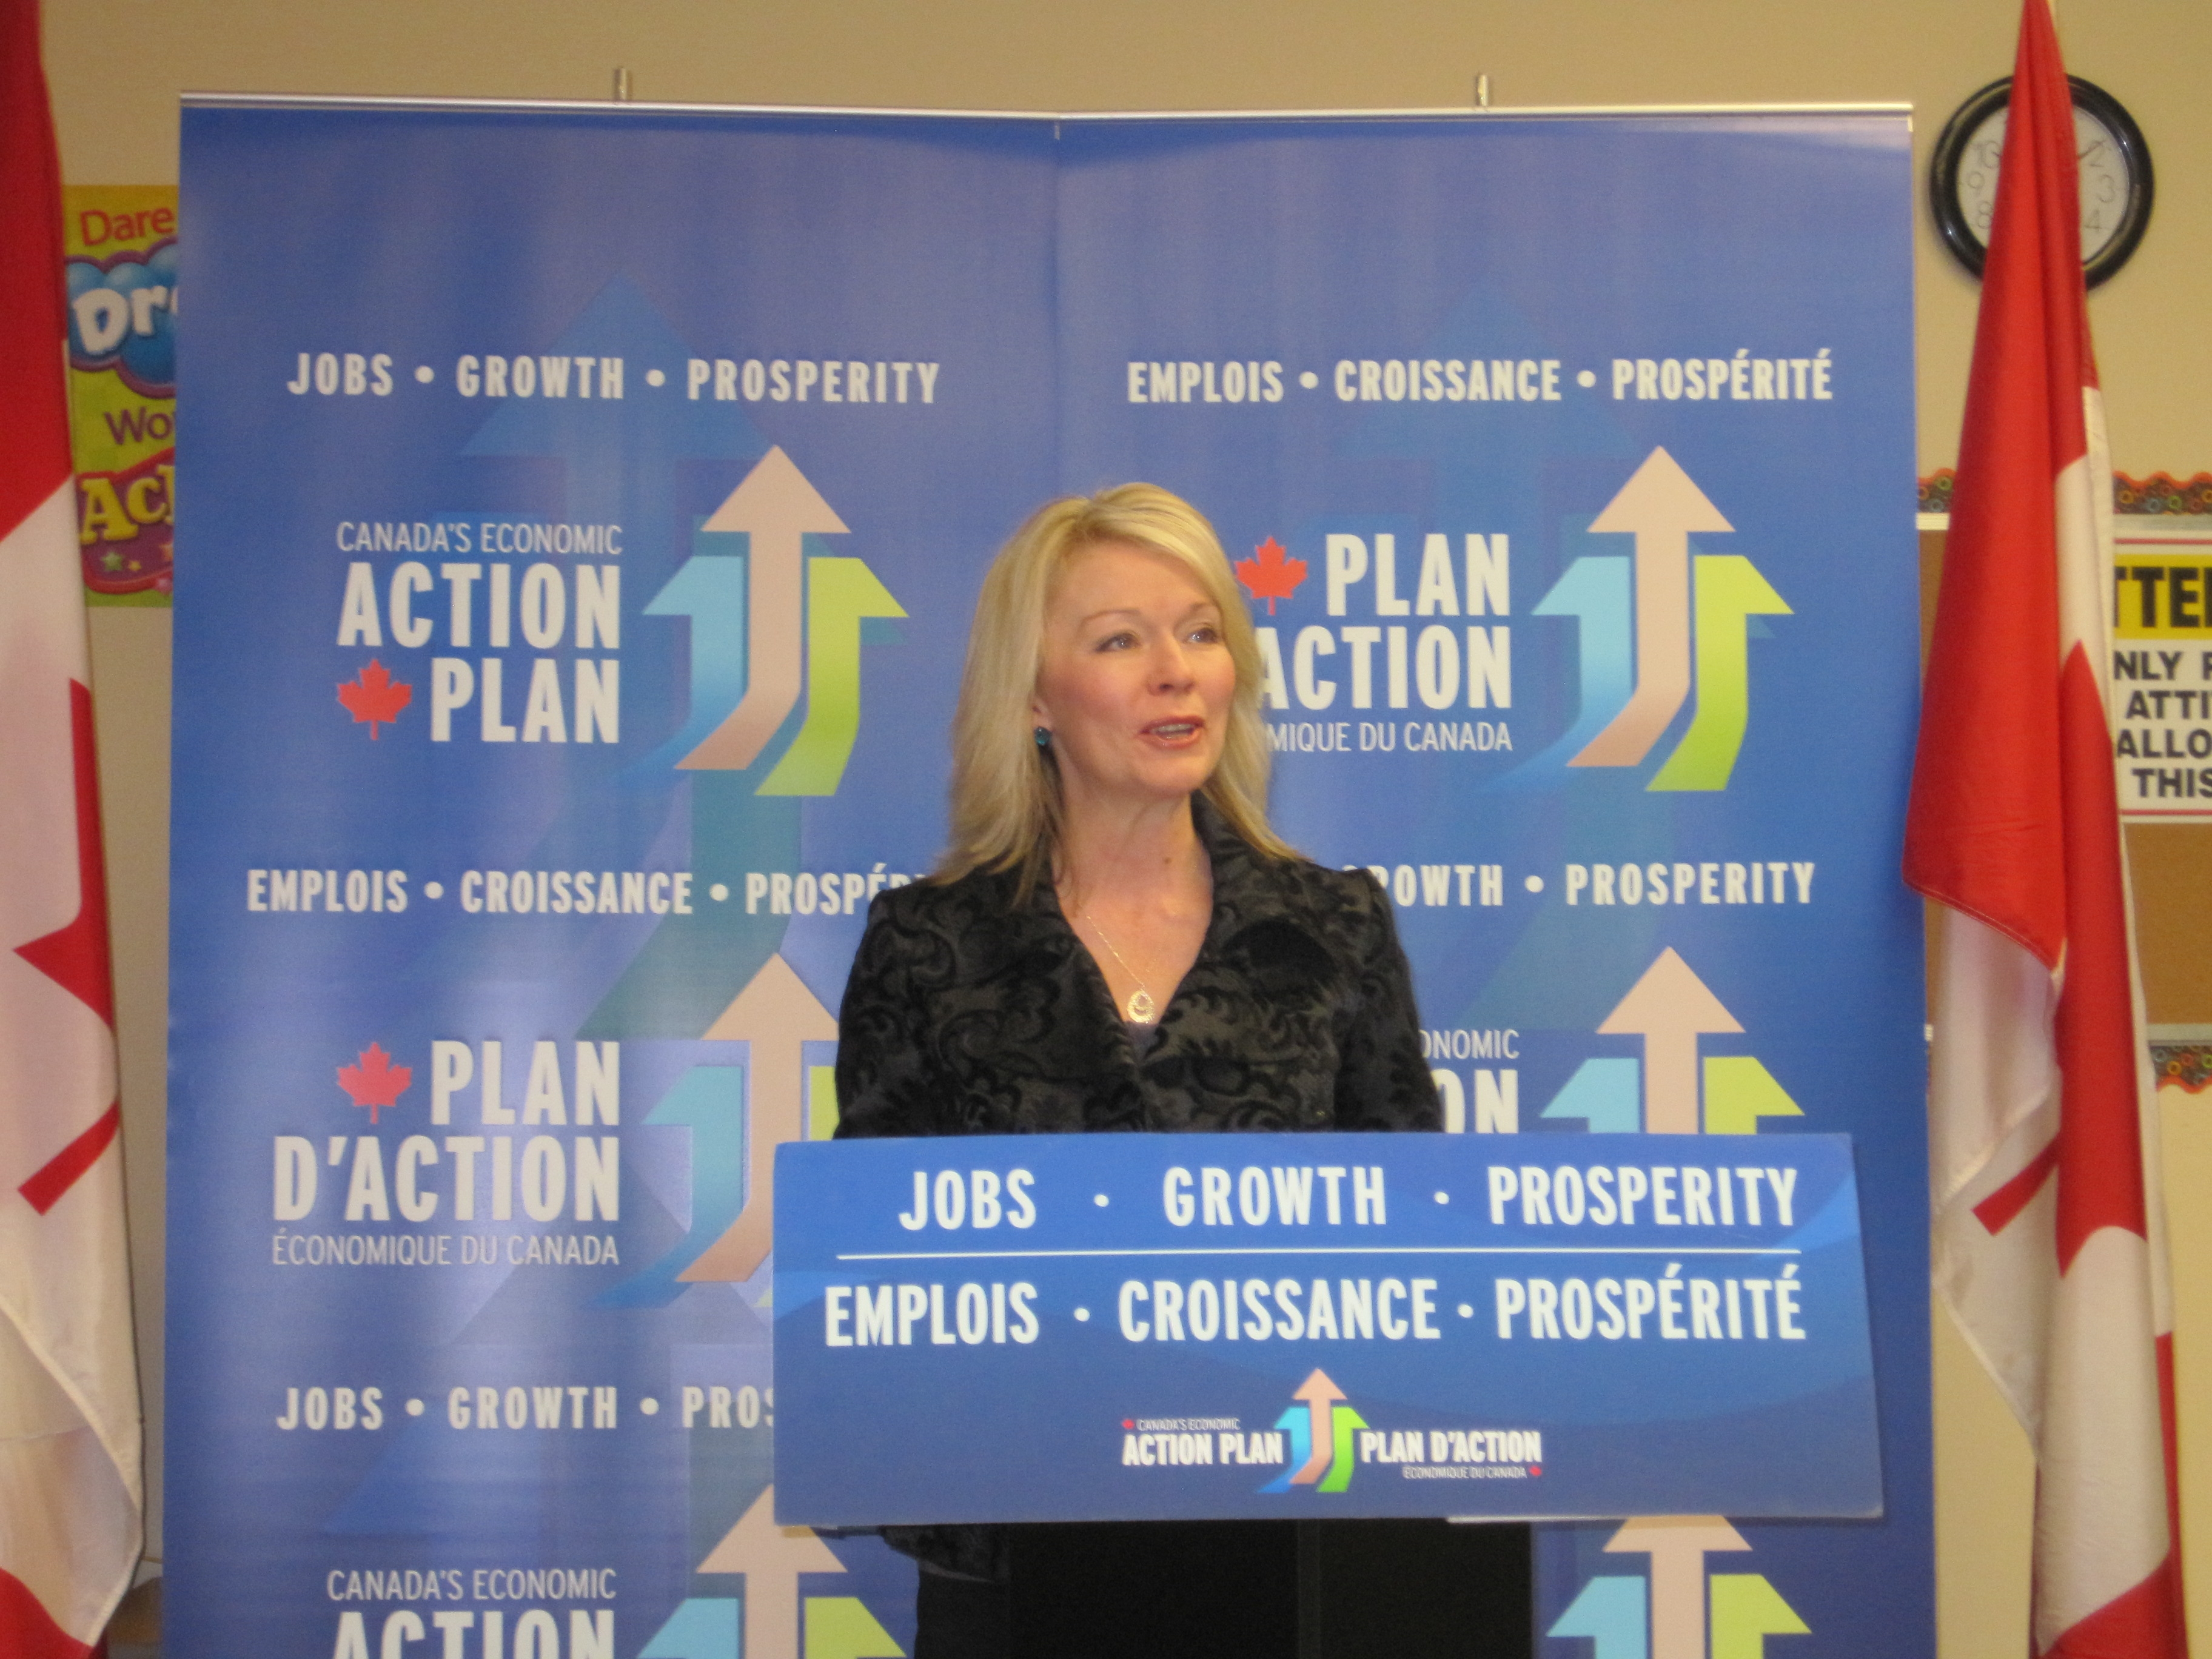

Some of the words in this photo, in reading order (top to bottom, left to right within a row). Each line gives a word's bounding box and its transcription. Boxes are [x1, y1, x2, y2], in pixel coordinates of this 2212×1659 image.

[79, 207, 174, 245] Dare
[71, 285, 178, 355] Dr
[287, 352, 394, 397] JOBS
[457, 355, 624, 400] GROWTH
[688, 358, 940, 404] PROSPERITY
[1127, 360, 1284, 403] EMPLOIS
[1335, 359, 1561, 402] CROISSANCE
[1612, 347, 1833, 401] PROSPÉRITÉ
[104, 406, 175, 446] Wo
[481, 523, 623, 555] ECONOMIC
[1326, 532, 1510, 617] PLAN
[337, 561, 621, 650] ACTION
[431, 657, 620, 744] PLAN
[1359, 721, 1395, 752] DU
[1403, 721, 1513, 752] CANADA
[247, 869, 407, 913] EMPLOIS
[461, 870, 693, 916] CROISSANCE
[745, 862, 927, 915] PROSPÉ
[1341, 863, 1504, 907] OWTH
[1566, 862, 1815, 906] PROSPERITY
[432, 1041, 619, 1127] PLAN
[898, 1168, 1037, 1232] JOBS
[1162, 1165, 1387, 1227] GROWTH
[1487, 1165, 1797, 1227] PROSPERITY
[272, 1227, 452, 1266] ÉCONOMIQUE
[462, 1235, 497, 1266] DU
[506, 1235, 620, 1266] CANADA
[825, 1281, 1039, 1347] EMPLOIS
[1118, 1277, 1441, 1343] CROISSANCE
[1495, 1262, 1806, 1341] PROSPÉRITÉ
[276, 1386, 383, 1431] JOBS
[447, 1386, 617, 1430] GROWTH
[1188, 1417, 1241, 1430] ECONOMIC
[1123, 1433, 1213, 1466] ACTION
[1219, 1432, 1283, 1464] PLAN
[1361, 1431, 1424, 1463] PLAN
[1470, 1466, 1485, 1478] DU
[1487, 1466, 1527, 1478] CANADA
[472, 1567, 616, 1601] ECONOMIC
[333, 1608, 614, 1659] ACTION
